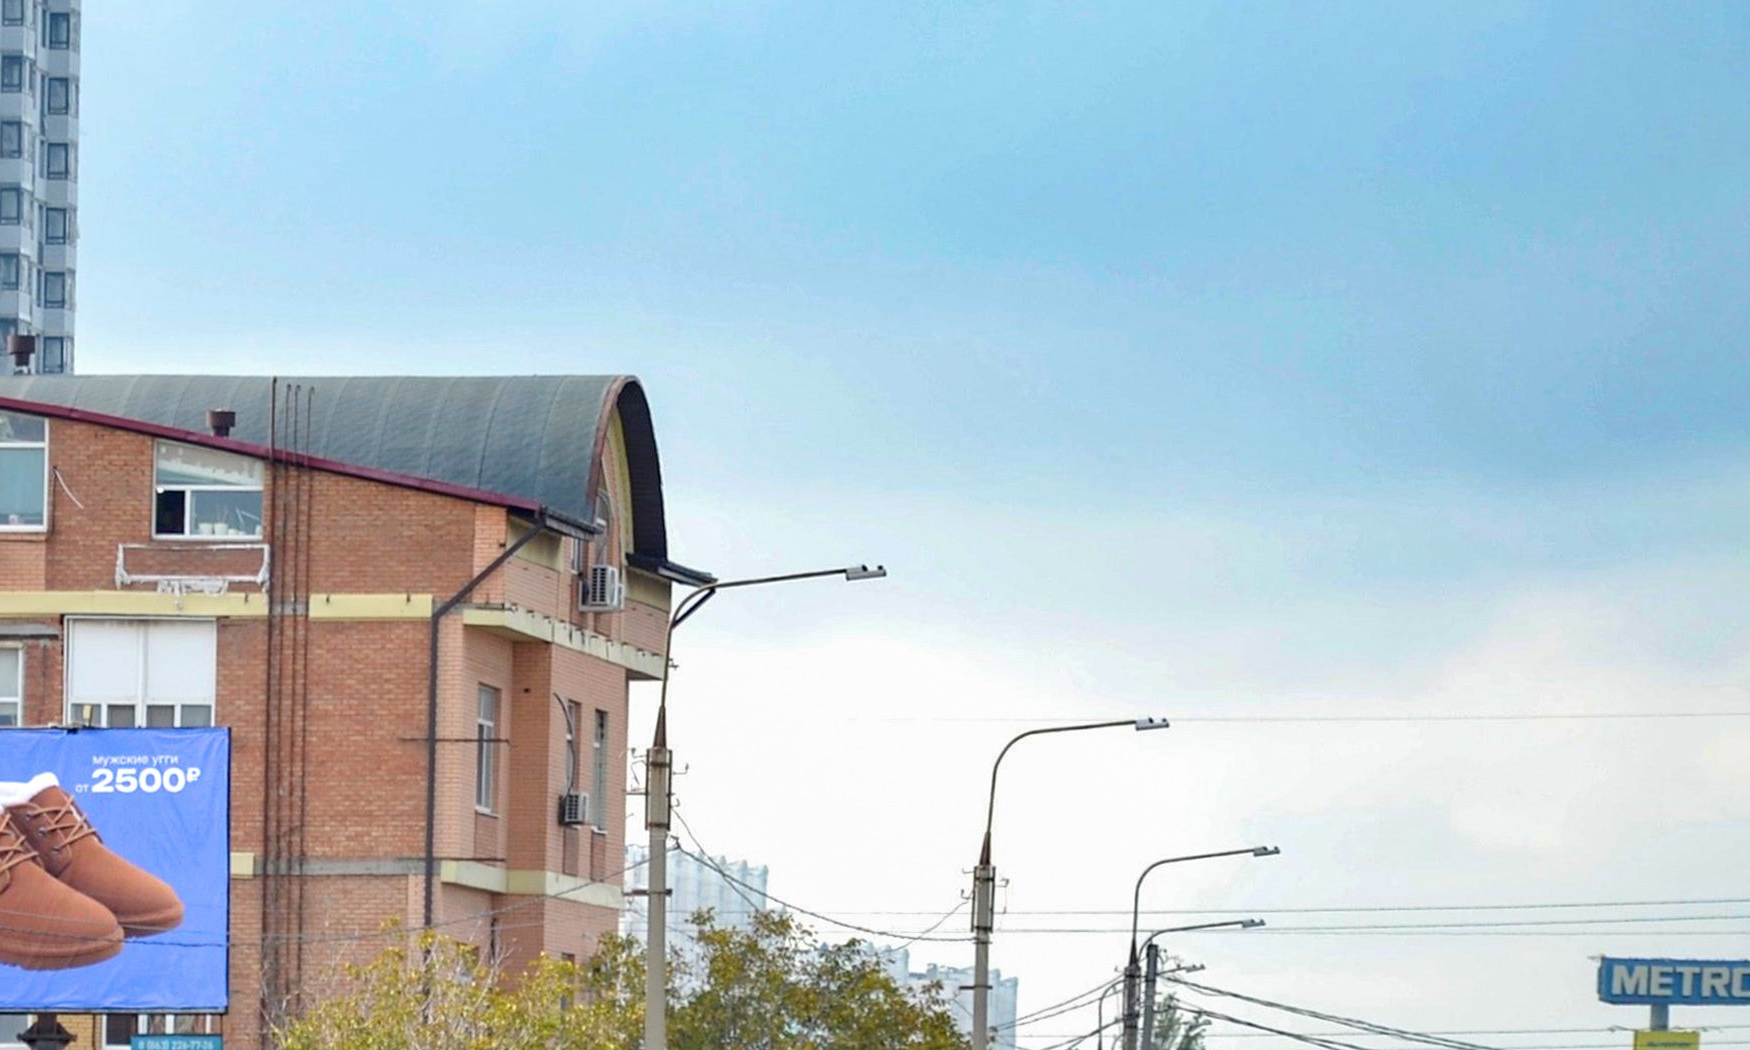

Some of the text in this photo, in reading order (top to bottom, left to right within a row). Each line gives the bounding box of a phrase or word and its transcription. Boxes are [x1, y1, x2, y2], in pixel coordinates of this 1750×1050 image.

[92, 755, 179, 767] мужские угги
[75, 784, 89, 793] от
[1611, 964, 1750, 998] METRO
